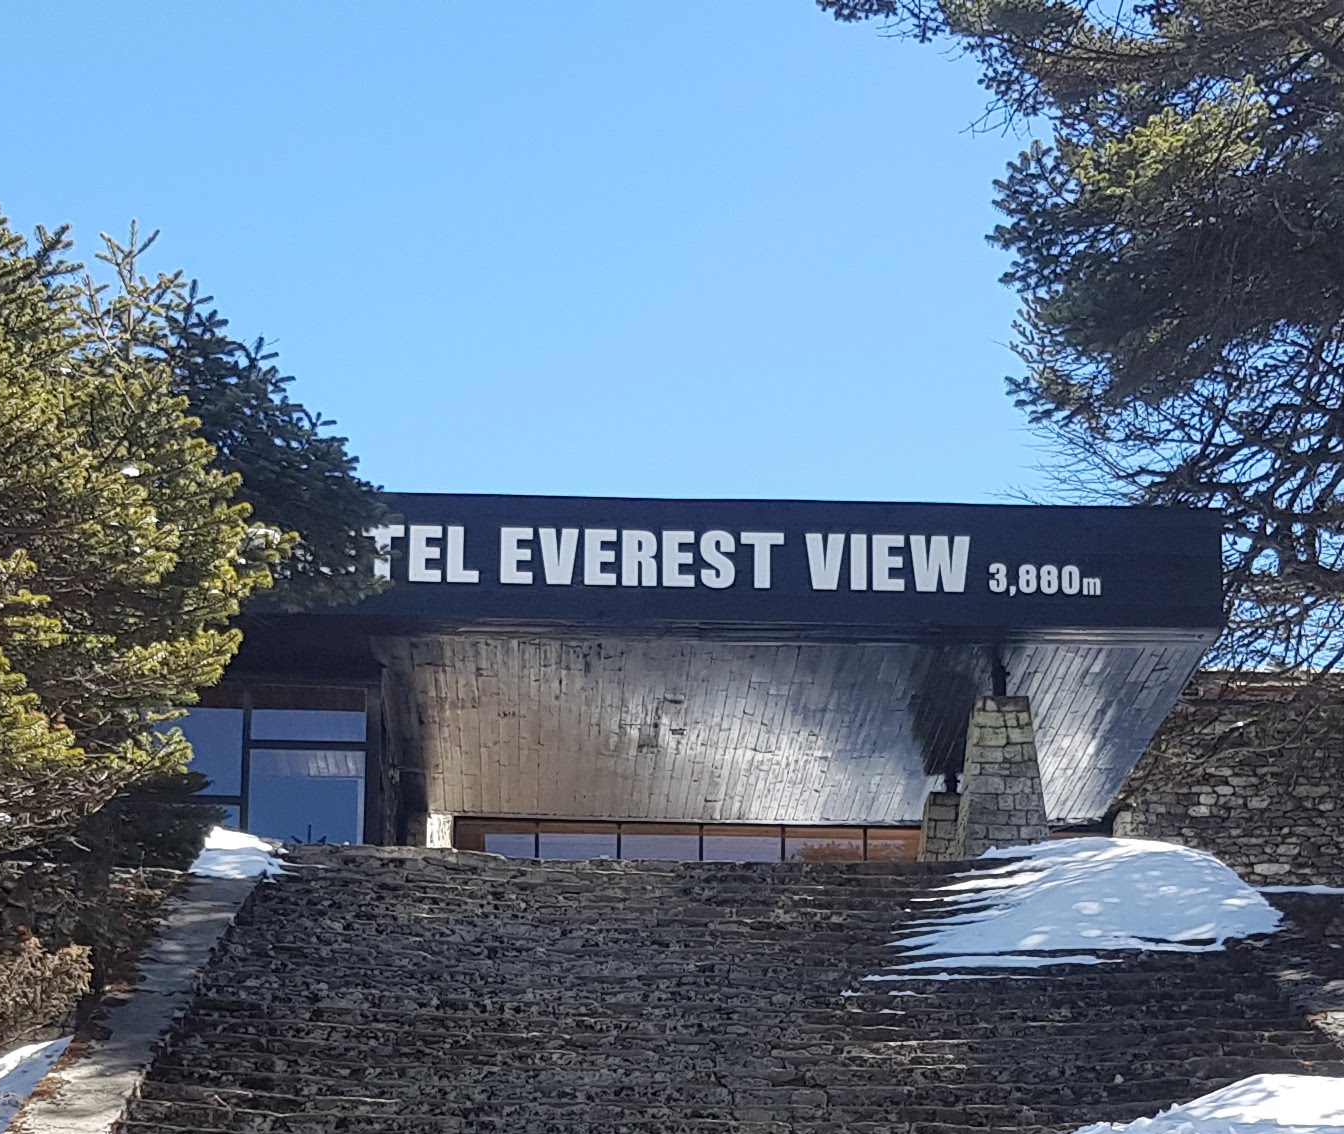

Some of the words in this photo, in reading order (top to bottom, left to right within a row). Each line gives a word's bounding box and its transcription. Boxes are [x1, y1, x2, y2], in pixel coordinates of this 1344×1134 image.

[276, 524, 479, 583] TEL
[500, 526, 785, 589] EVEREST
[805, 533, 971, 593] VIEW
[988, 562, 1102, 597] 3,880m
